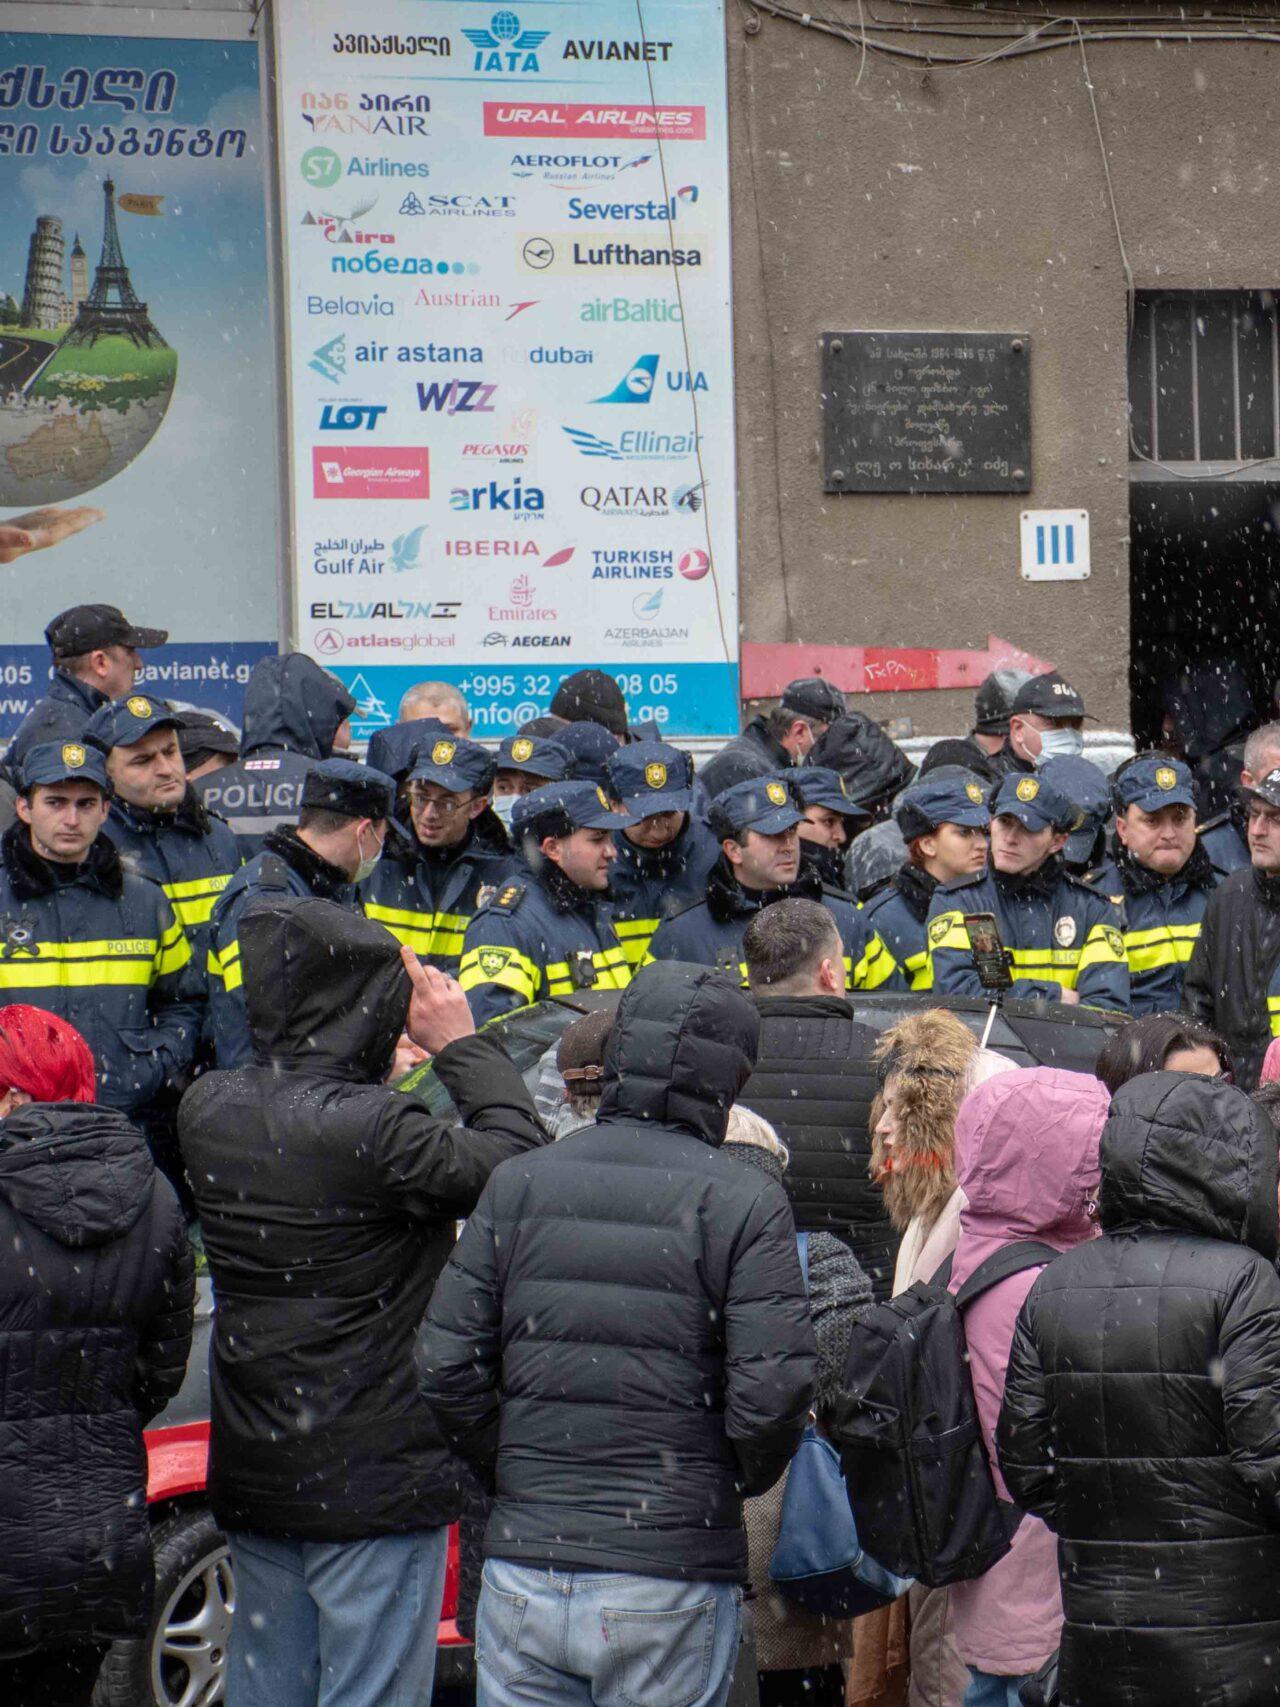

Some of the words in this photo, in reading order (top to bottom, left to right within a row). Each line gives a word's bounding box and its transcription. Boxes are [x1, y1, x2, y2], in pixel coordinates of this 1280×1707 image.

[332, 33, 451, 56] ავიაქსელი
[562, 40, 674, 62] AVIANET
[474, 52, 540, 72] IATA
[359, 93, 431, 112] აირი
[301, 113, 431, 136] YANAIR
[496, 108, 567, 124] URAL
[576, 110, 693, 126] AIRLINES
[49, 125, 247, 158] სააგენტო
[307, 155, 334, 178] S7
[347, 155, 430, 178] Airlines
[510, 154, 622, 168] AEROFLOT
[581, 172, 616, 181] Airlines
[428, 195, 516, 208] SCAT
[568, 197, 677, 221] Severstal
[428, 209, 516, 217] AIRLINES
[573, 243, 701, 266] Lufthansa
[308, 293, 394, 316] Belavia
[415, 288, 501, 308] Austrian
[580, 297, 682, 324] airBaltic
[355, 342, 389, 364] air
[397, 344, 483, 364] astana
[529, 346, 594, 364] dubai
[666, 370, 709, 392] UIA
[319, 405, 388, 430] LOT
[462, 443, 529, 456] PEGASUS
[620, 430, 704, 453] Ellinair
[343, 466, 384, 479] Georgian
[385, 466, 421, 479] Airways
[448, 477, 545, 510] arkia
[580, 486, 668, 511] QATAR
[314, 538, 348, 557] الخليج
[350, 538, 385, 555] طيران
[445, 540, 540, 557] IBERIA
[592, 549, 674, 564] TURKISH
[314, 559, 355, 575] Gulf
[358, 559, 385, 575] Air
[592, 565, 674, 580] AIRLINES
[488, 605, 558, 622] Emirates
[346, 633, 456, 651] atlasglobal
[512, 635, 571, 648] AEGEAN
[604, 627, 689, 640] AZERBAIJAN
[622, 639, 664, 648] AIRLINES
[458, 675, 515, 697] +995
[523, 675, 551, 696] 32
[650, 673, 678, 695] 05
[107, 941, 151, 954] POLICE
